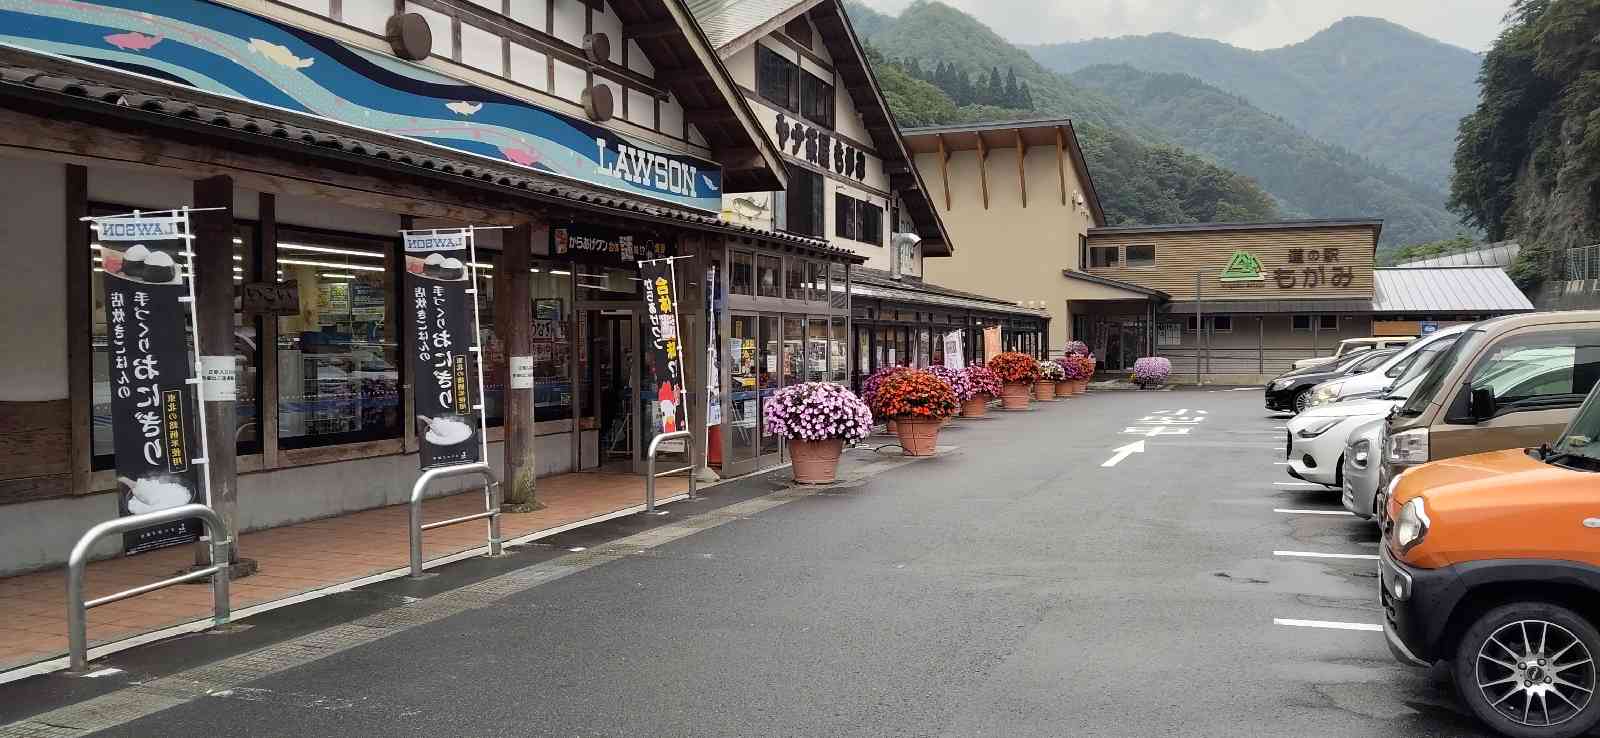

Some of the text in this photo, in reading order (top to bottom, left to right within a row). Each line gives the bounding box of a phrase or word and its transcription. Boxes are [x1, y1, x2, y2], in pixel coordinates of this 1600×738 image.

[596, 138, 698, 198] LAWSON
[1288, 247, 1340, 264] 道の駅
[1273, 265, 1354, 289] もがみ
